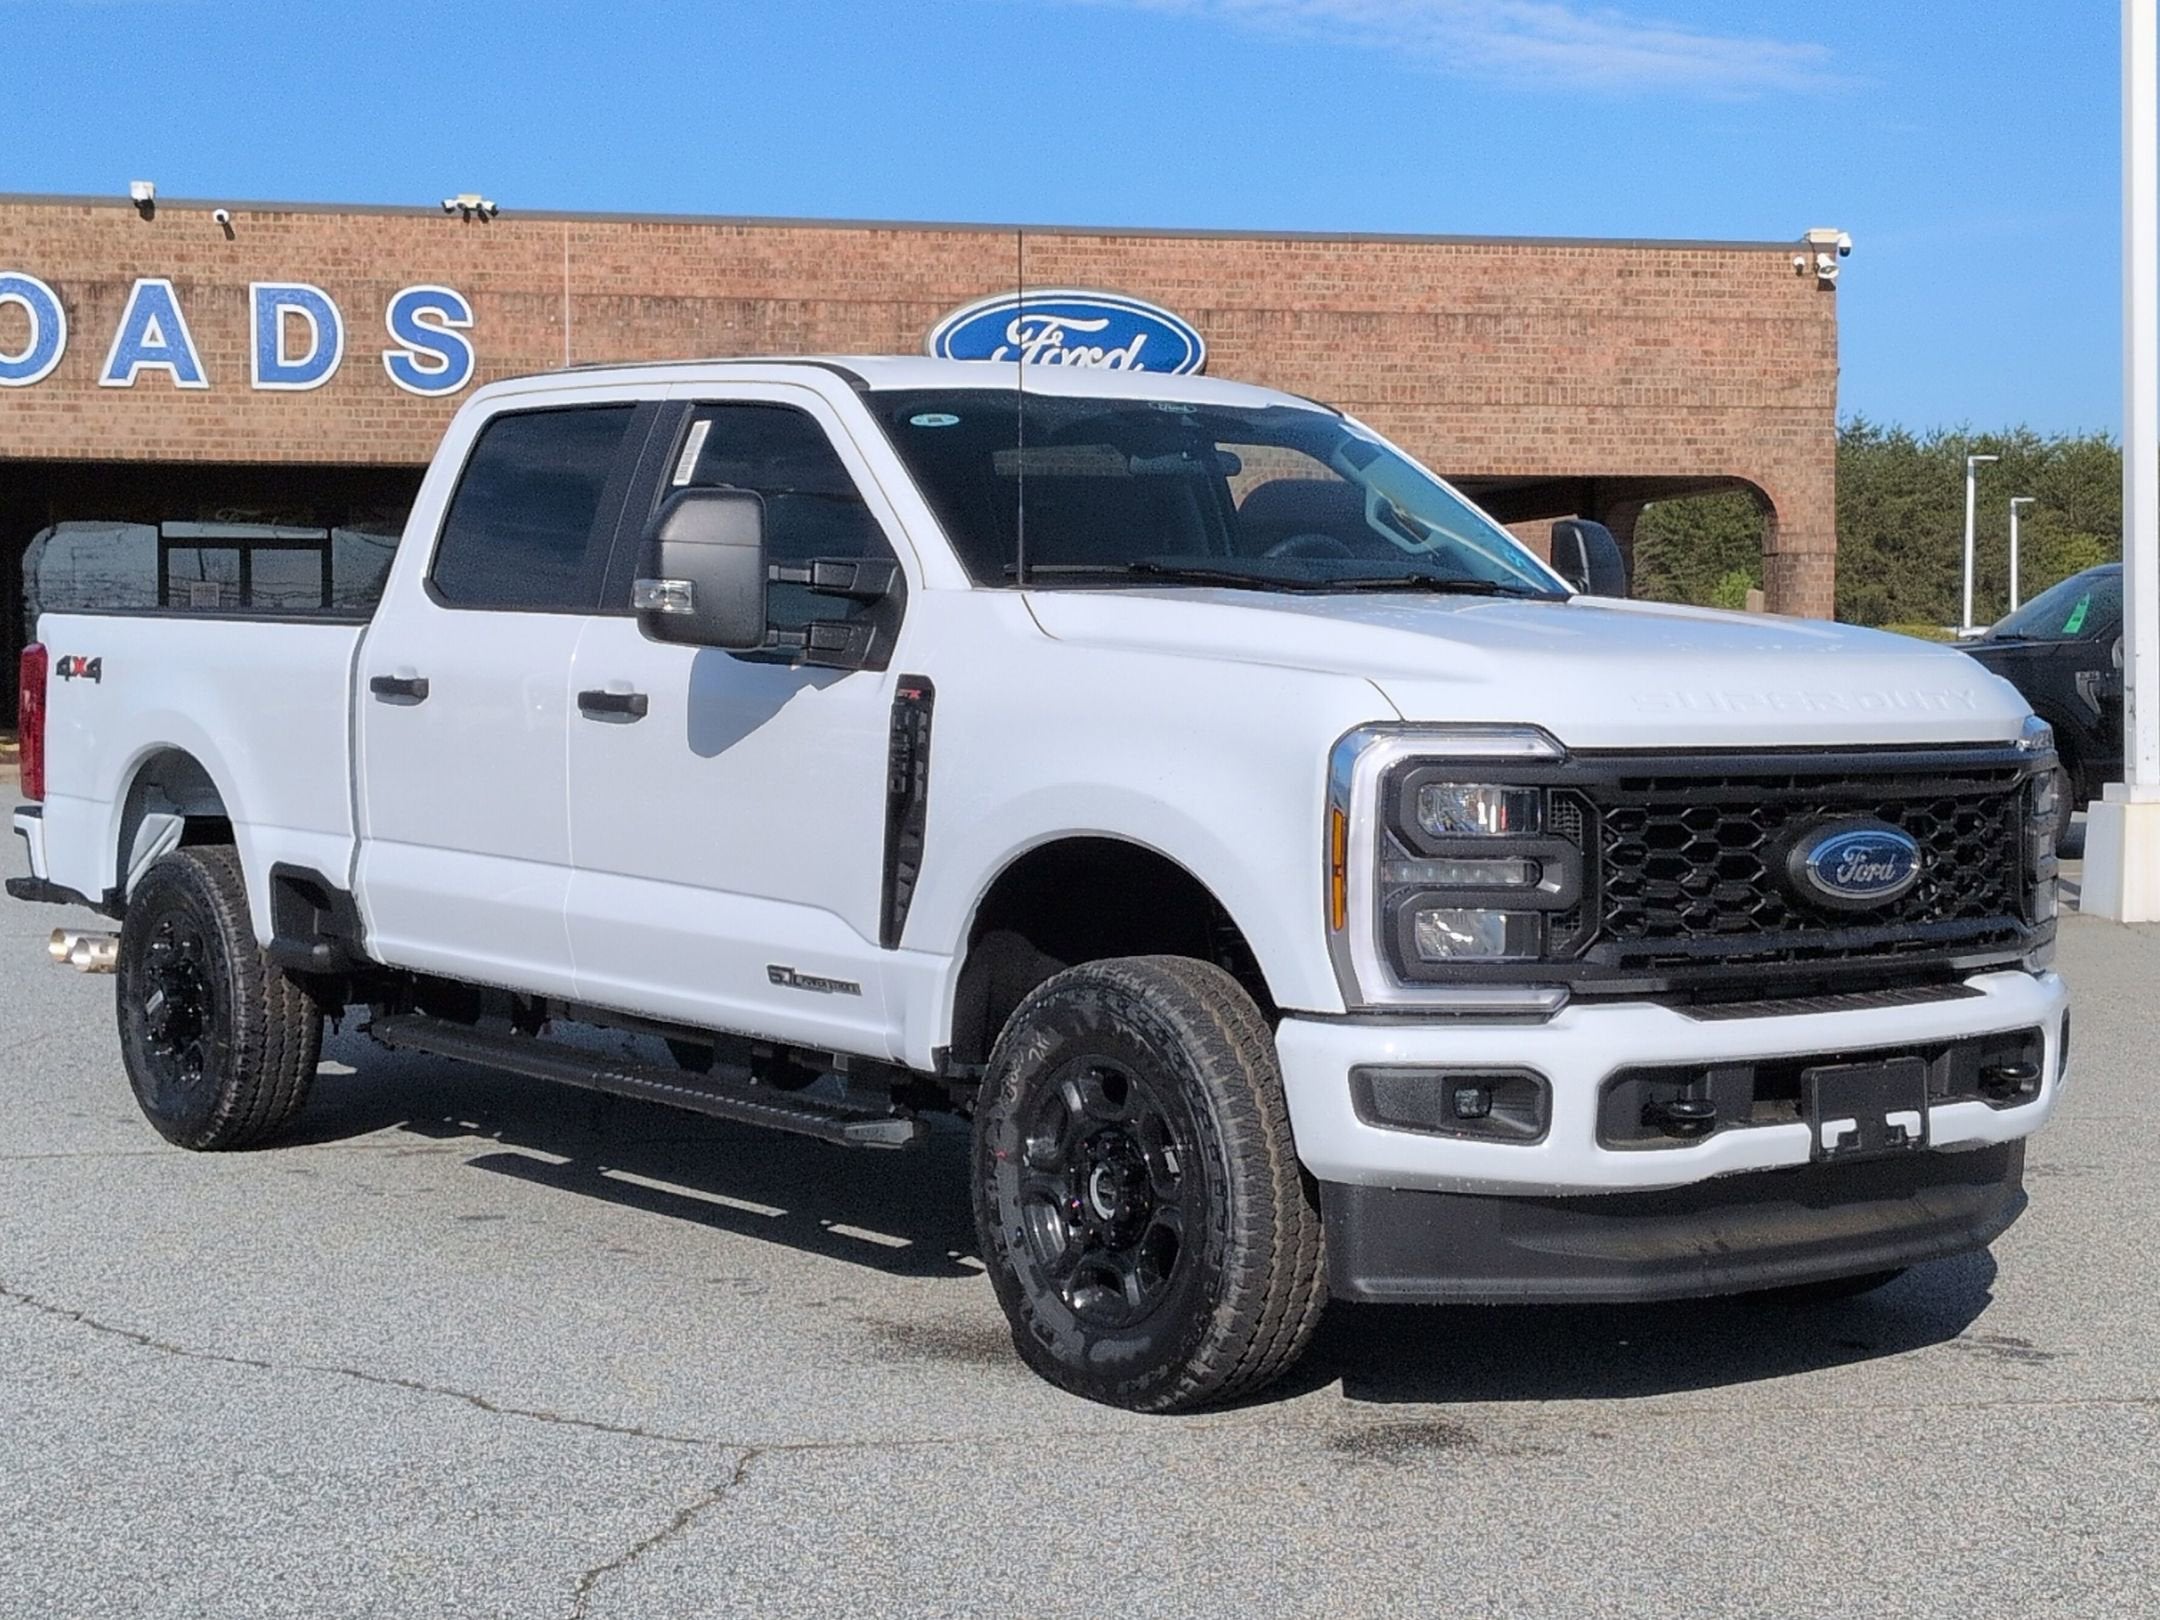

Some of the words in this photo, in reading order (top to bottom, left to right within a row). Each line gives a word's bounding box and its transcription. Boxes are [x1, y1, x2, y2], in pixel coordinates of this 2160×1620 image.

[991, 314, 1148, 371] Ford
[1632, 689, 1850, 713] SUPER
[1854, 688, 1978, 712] DUTY
[1836, 845, 1896, 883] Ford
